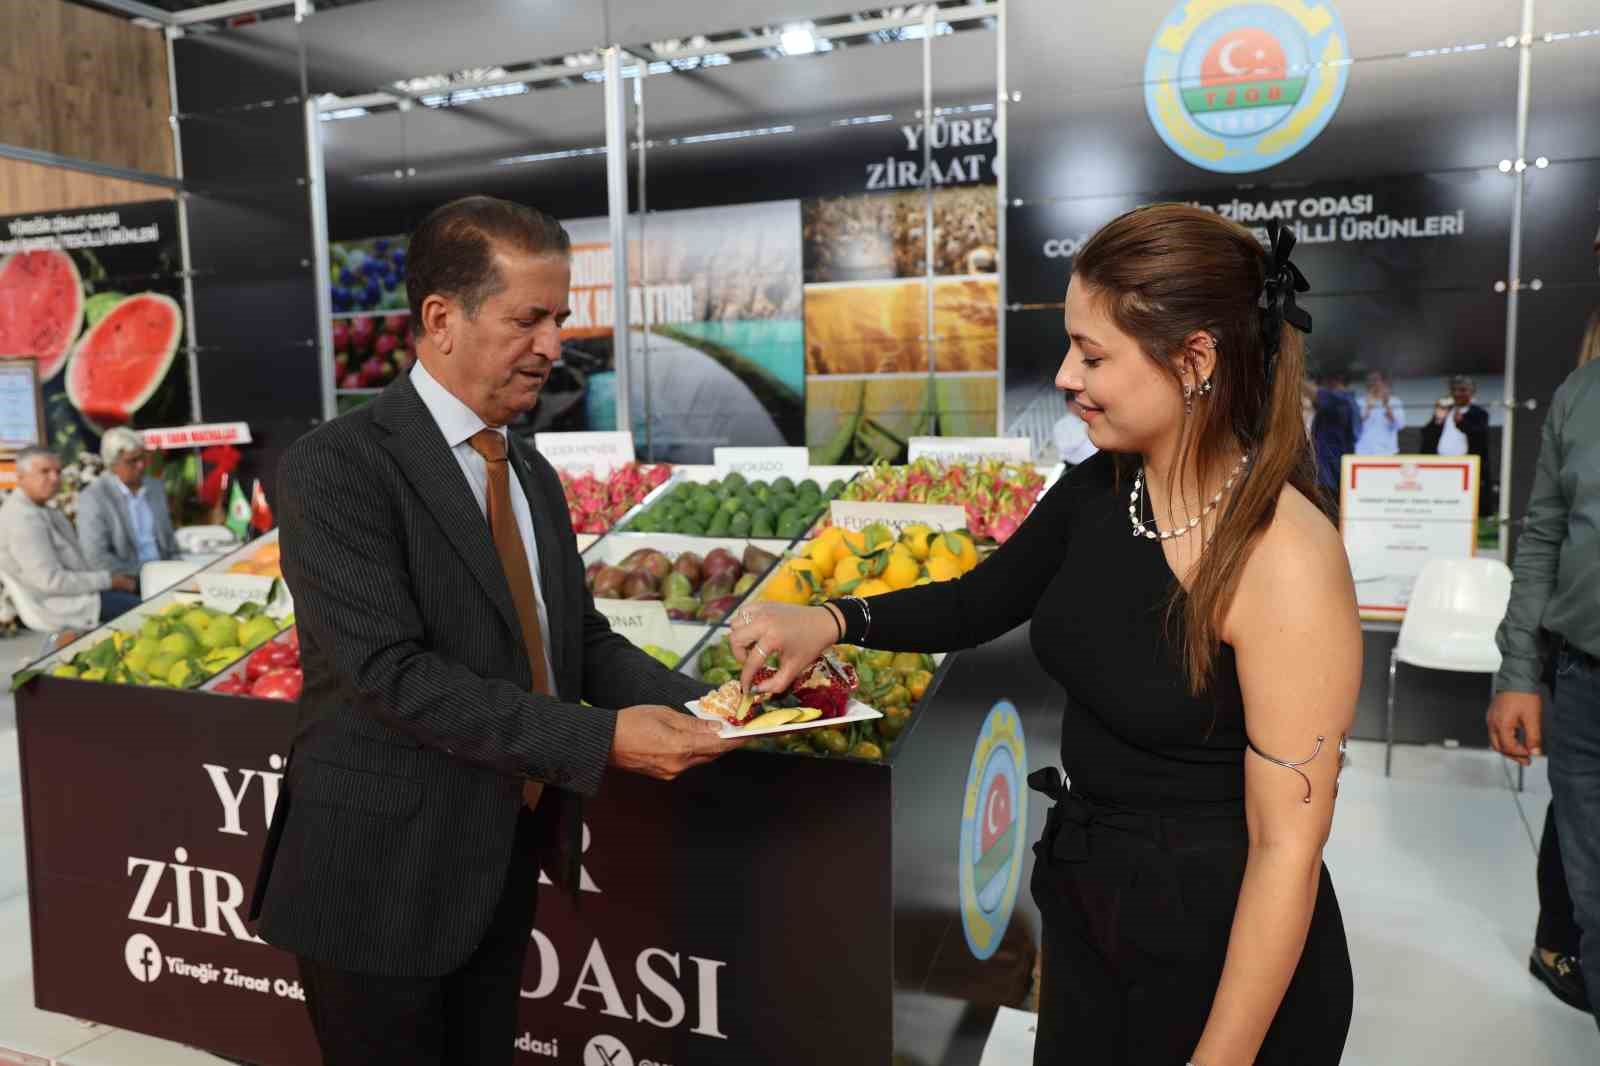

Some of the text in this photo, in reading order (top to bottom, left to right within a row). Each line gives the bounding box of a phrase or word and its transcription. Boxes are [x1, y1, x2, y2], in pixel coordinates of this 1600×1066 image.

[865, 153, 986, 190] ZİRAAT
[1300, 195, 1373, 218] ODASI
[1340, 210, 1465, 241] ÜRÜNLERİ
[164, 955, 220, 984] Yüreğir
[223, 967, 270, 993] Ziraat
